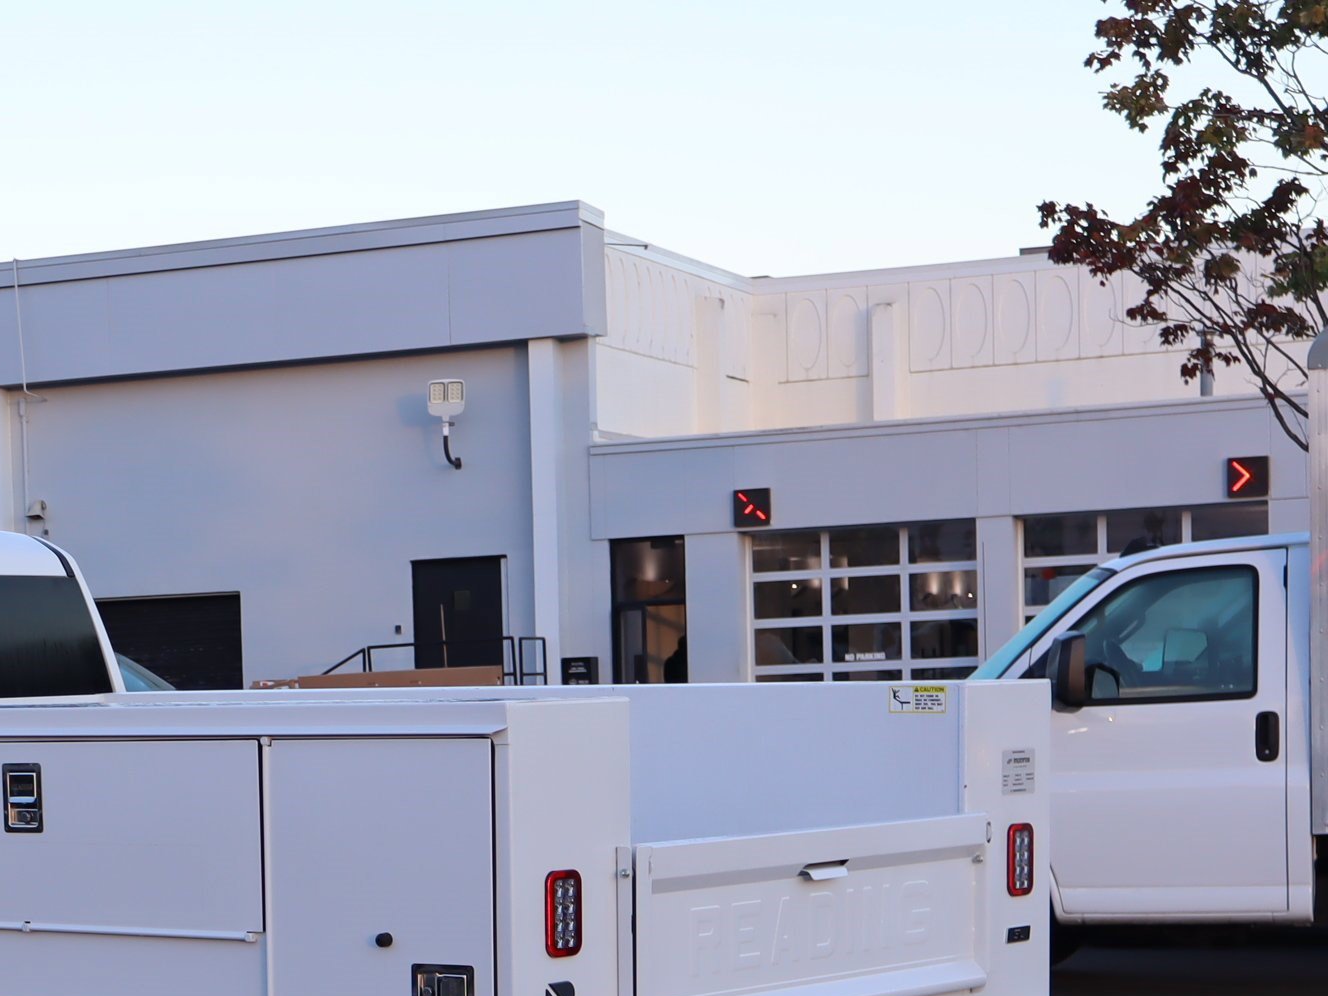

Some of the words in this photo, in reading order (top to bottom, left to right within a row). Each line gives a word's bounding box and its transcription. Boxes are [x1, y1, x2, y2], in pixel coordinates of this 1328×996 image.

[844, 653, 855, 661] NO
[856, 652, 886, 660] PARKING
[689, 881, 932, 977] READING
